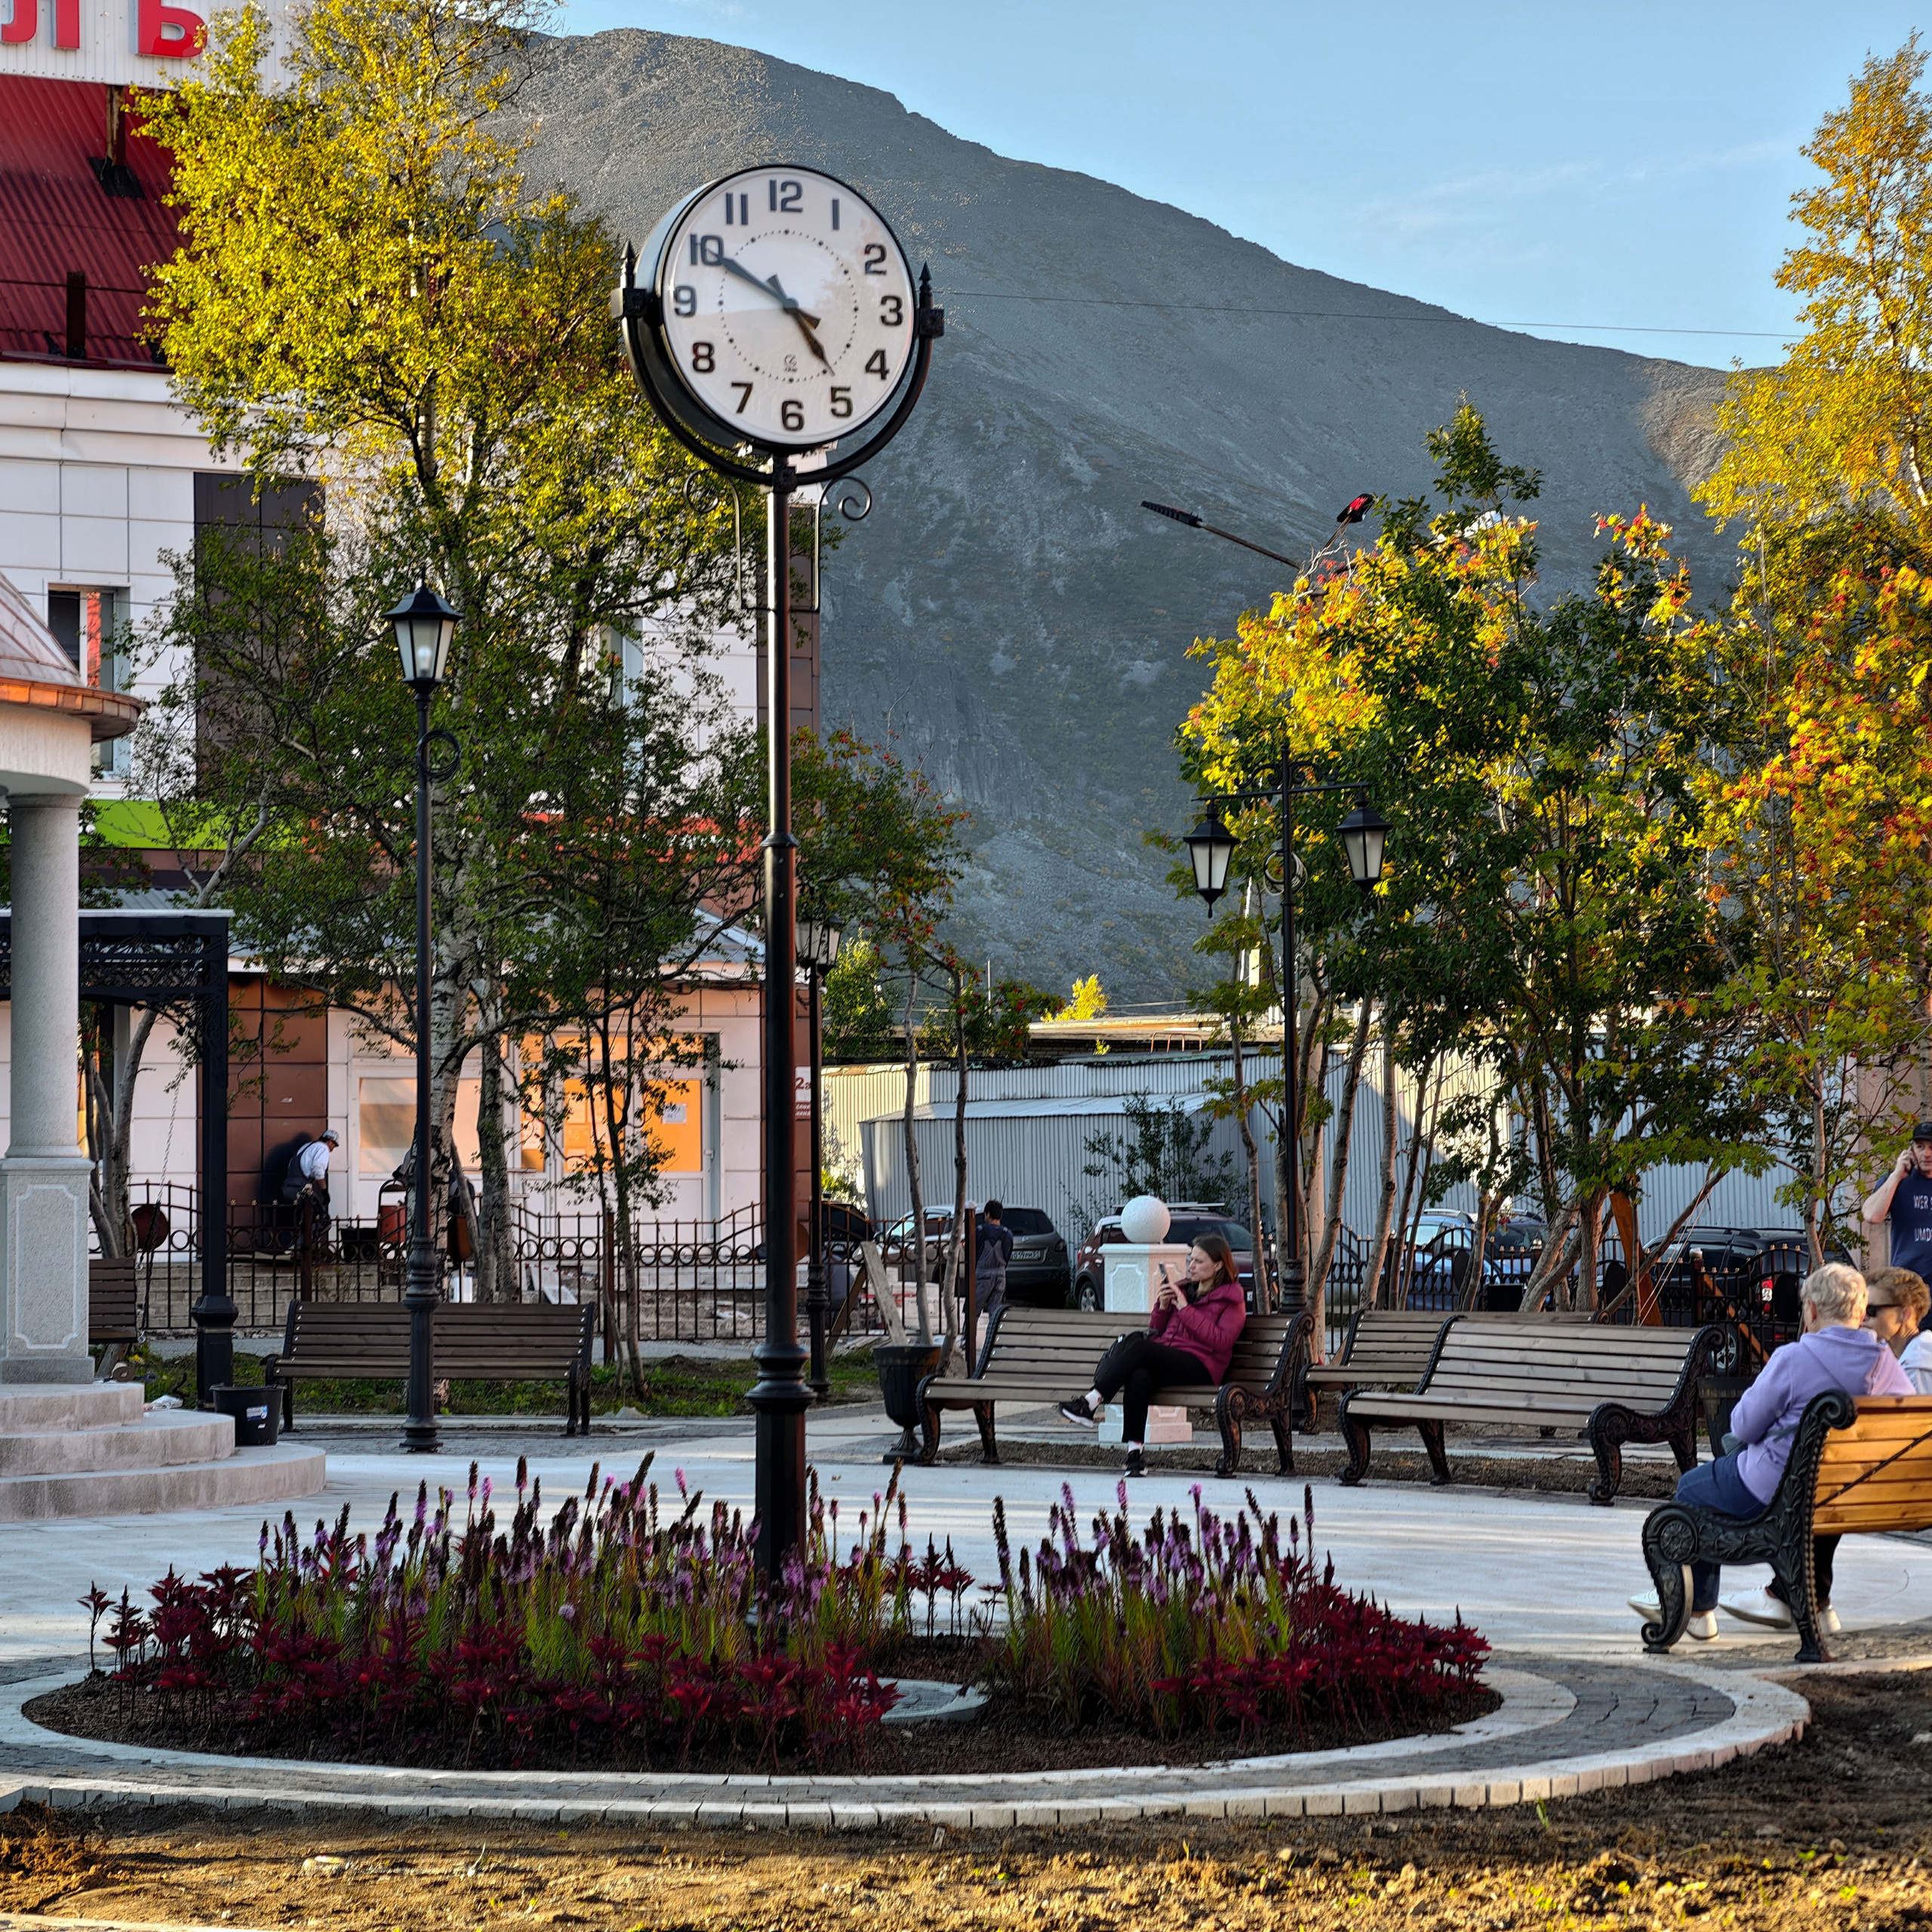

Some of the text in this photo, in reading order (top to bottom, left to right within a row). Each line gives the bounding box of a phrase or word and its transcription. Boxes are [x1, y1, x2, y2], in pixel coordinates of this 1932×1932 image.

[725, 192, 749, 226] 11
[769, 180, 803, 213] 12
[832, 198, 841, 230] 1
[690, 233, 724, 266] 10
[864, 244, 887, 275] 2
[674, 285, 697, 317] 9
[880, 295, 903, 327] 3
[692, 342, 715, 373] 8
[865, 349, 891, 380] 4
[731, 382, 753, 414] 7
[830, 386, 853, 418] 5
[781, 400, 804, 432] 6
[1913, 1195, 1929, 1209] WER
